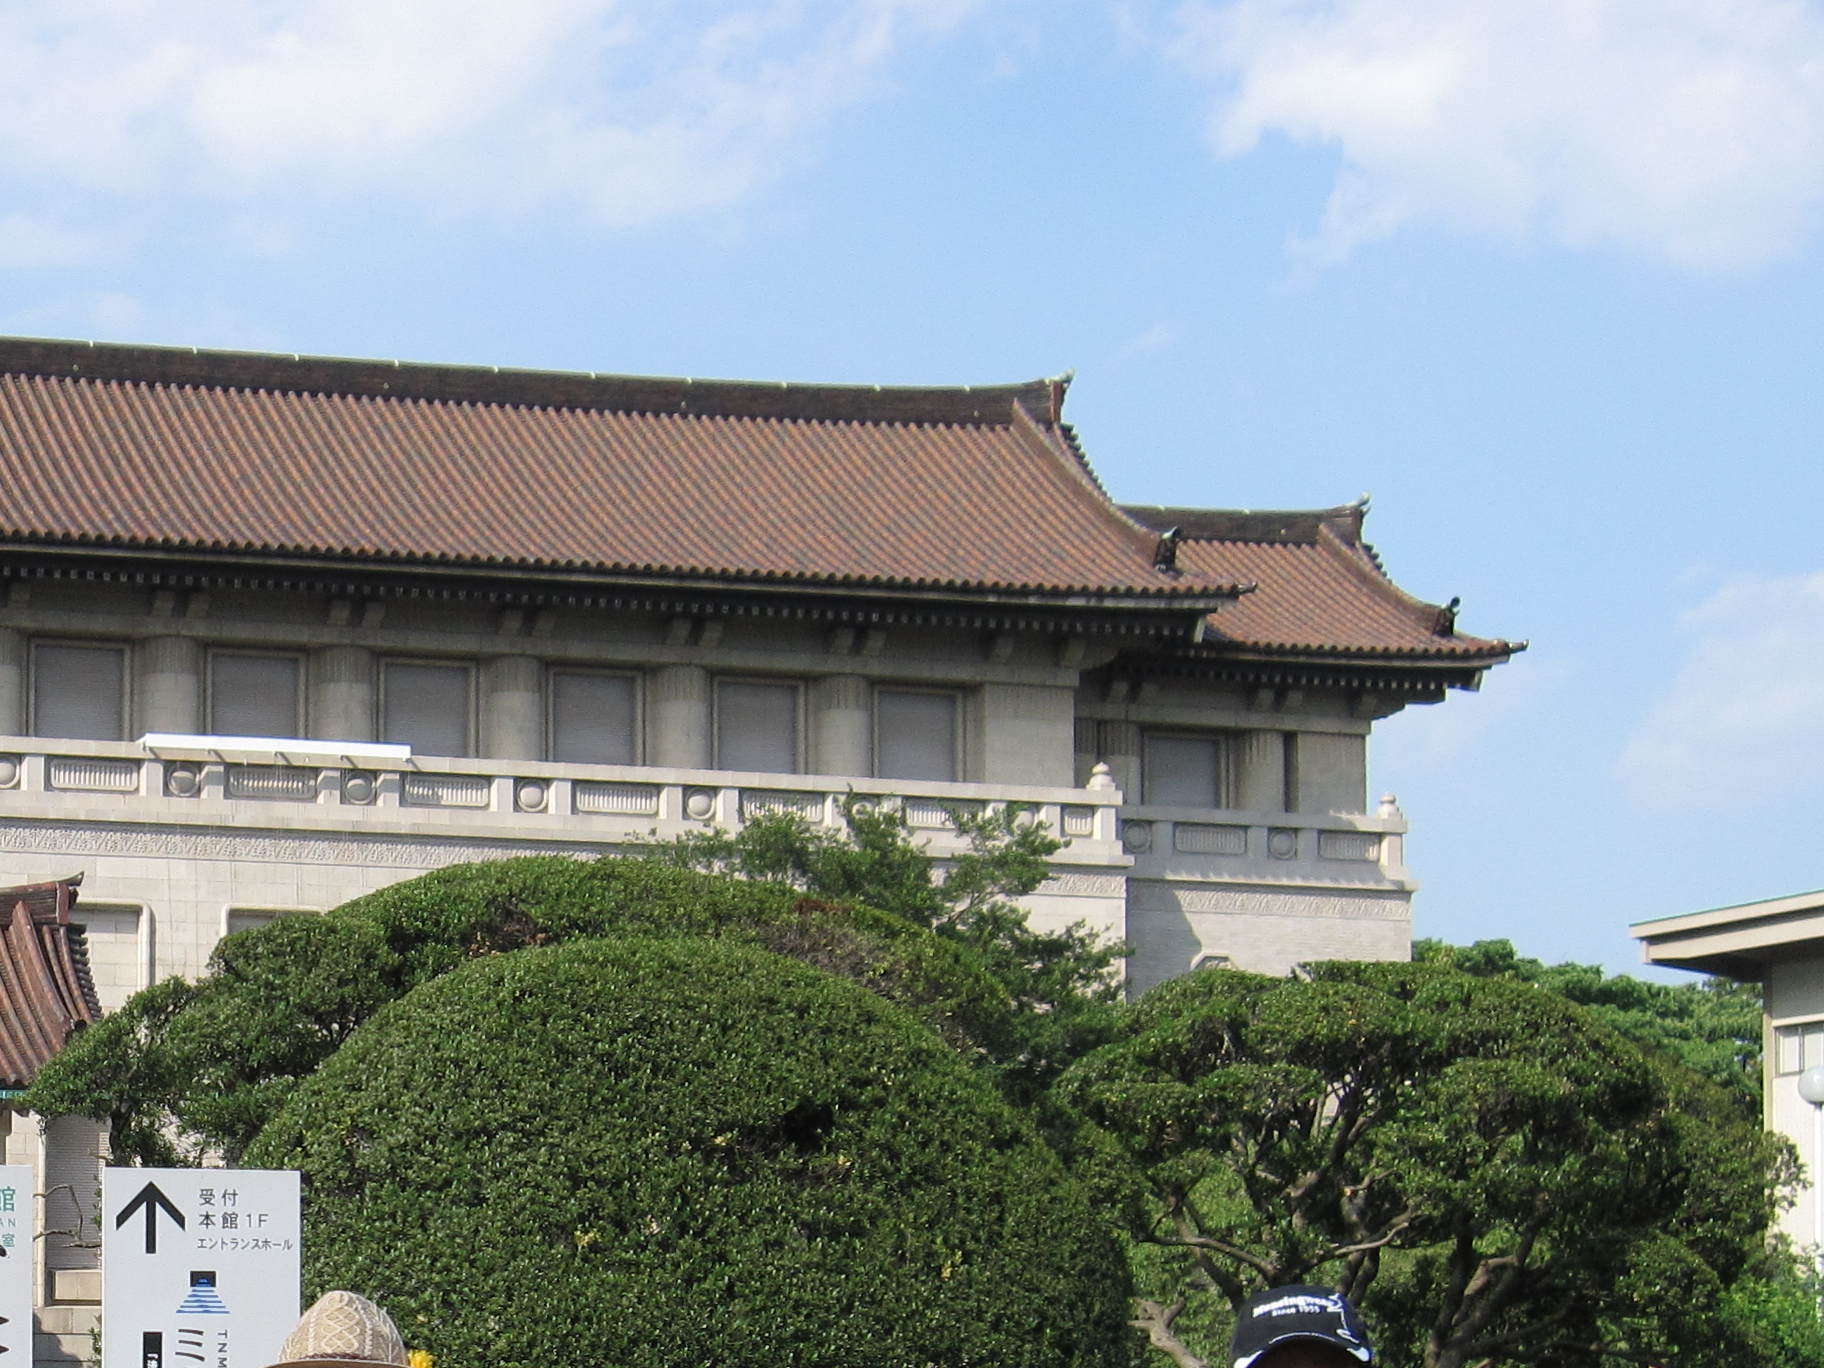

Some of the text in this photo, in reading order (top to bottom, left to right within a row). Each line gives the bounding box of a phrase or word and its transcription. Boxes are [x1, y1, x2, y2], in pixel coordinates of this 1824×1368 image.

[199, 1188, 239, 1207] 受付
[197, 1238, 293, 1251] エントランスホール
[216, 1329, 228, 1368] TNM
